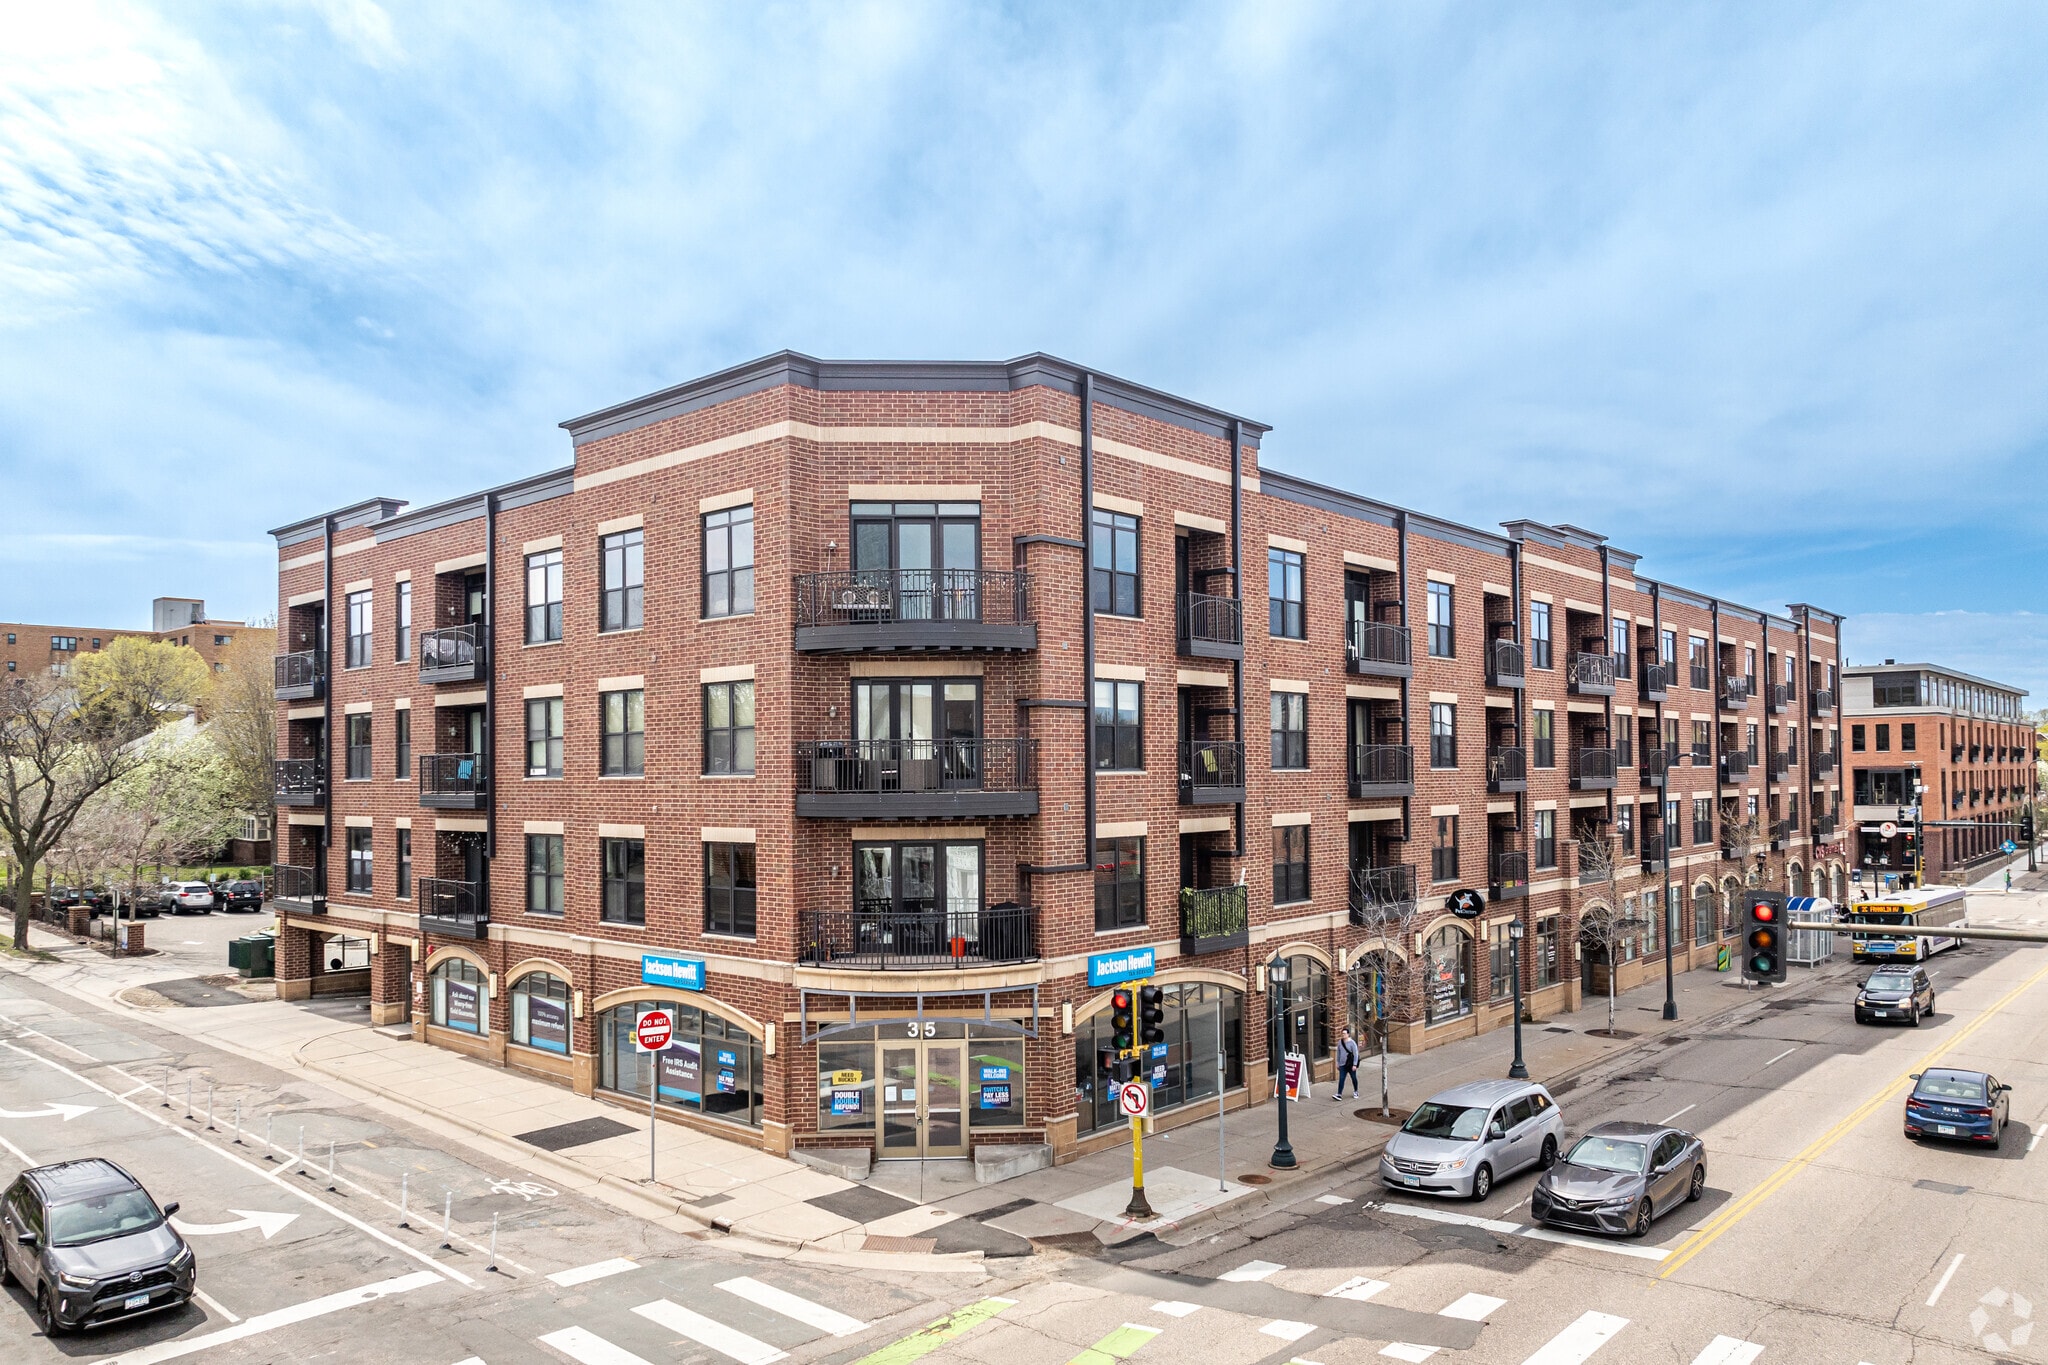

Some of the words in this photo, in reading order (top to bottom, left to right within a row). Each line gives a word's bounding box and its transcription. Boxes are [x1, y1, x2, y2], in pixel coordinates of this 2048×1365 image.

[644, 958, 672, 977] Jackson
[673, 962, 697, 980] Hewitt
[1096, 958, 1127, 976] Jackson
[1128, 952, 1152, 970] Hewitt
[642, 1019, 651, 1027] DO
[654, 1017, 667, 1025] NOT
[907, 1021, 936, 1037] 35
[644, 1035, 664, 1044] ENTER
[662, 1055, 673, 1065] Free
[673, 1058, 683, 1067] IRS
[684, 1060, 698, 1070] Audit
[665, 1066, 695, 1079] Assistance.
